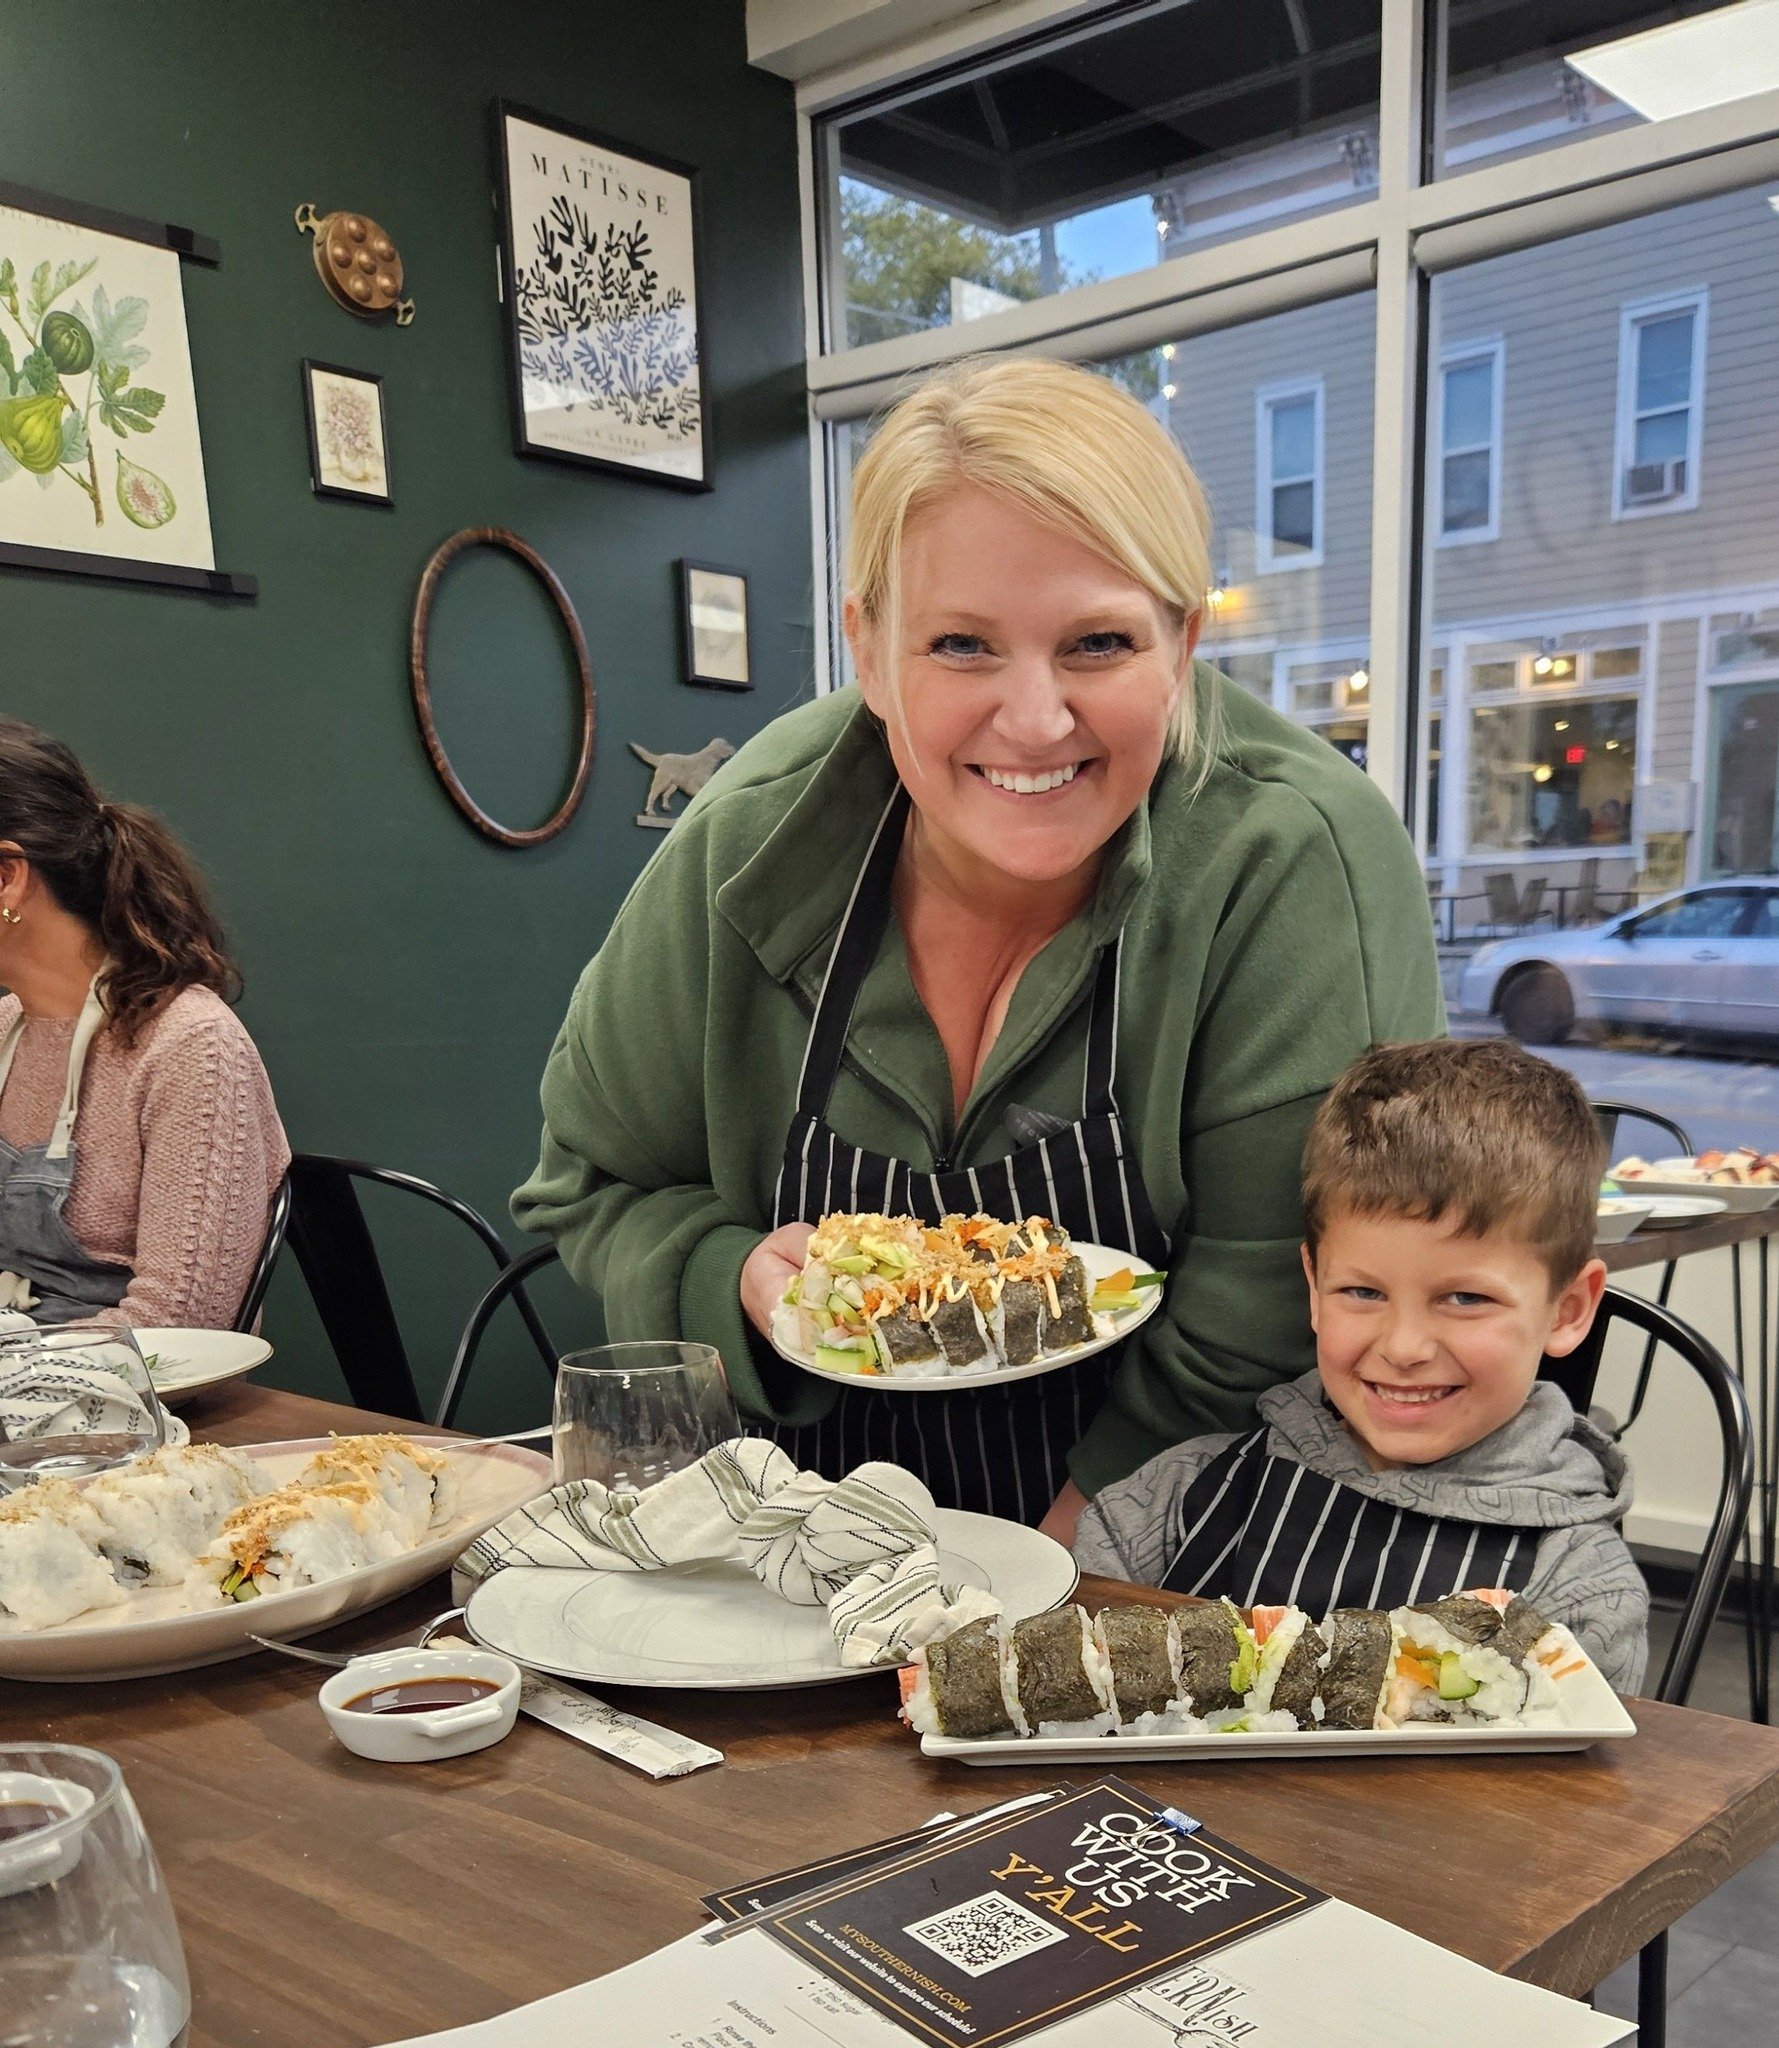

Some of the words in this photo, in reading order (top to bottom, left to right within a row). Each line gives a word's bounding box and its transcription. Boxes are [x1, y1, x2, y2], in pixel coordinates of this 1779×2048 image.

[531, 153, 668, 215] MATISSE
[1064, 1857, 1149, 1907] US
[1070, 1822, 1223, 1914] WITH
[1100, 1813, 1256, 1900] COOK
[990, 1852, 1143, 1952] Y'ALL
[805, 1919, 825, 1934] Scan
[823, 1932, 835, 1940] or
[832, 1938, 851, 1951] visit
[846, 1949, 863, 1959] our
[859, 1957, 888, 1979] website
[885, 1975, 897, 1984] to
[893, 1981, 925, 2003] explore
[921, 2000, 939, 2011] our
[935, 2009, 977, 2035] schedule!
[839, 1924, 972, 2013] MYSOUTHERNISH.COM
[1145, 1966, 1259, 2042] ERNISH
[722, 2026, 745, 2041] Rinse
[727, 2000, 777, 2035] Instructions
